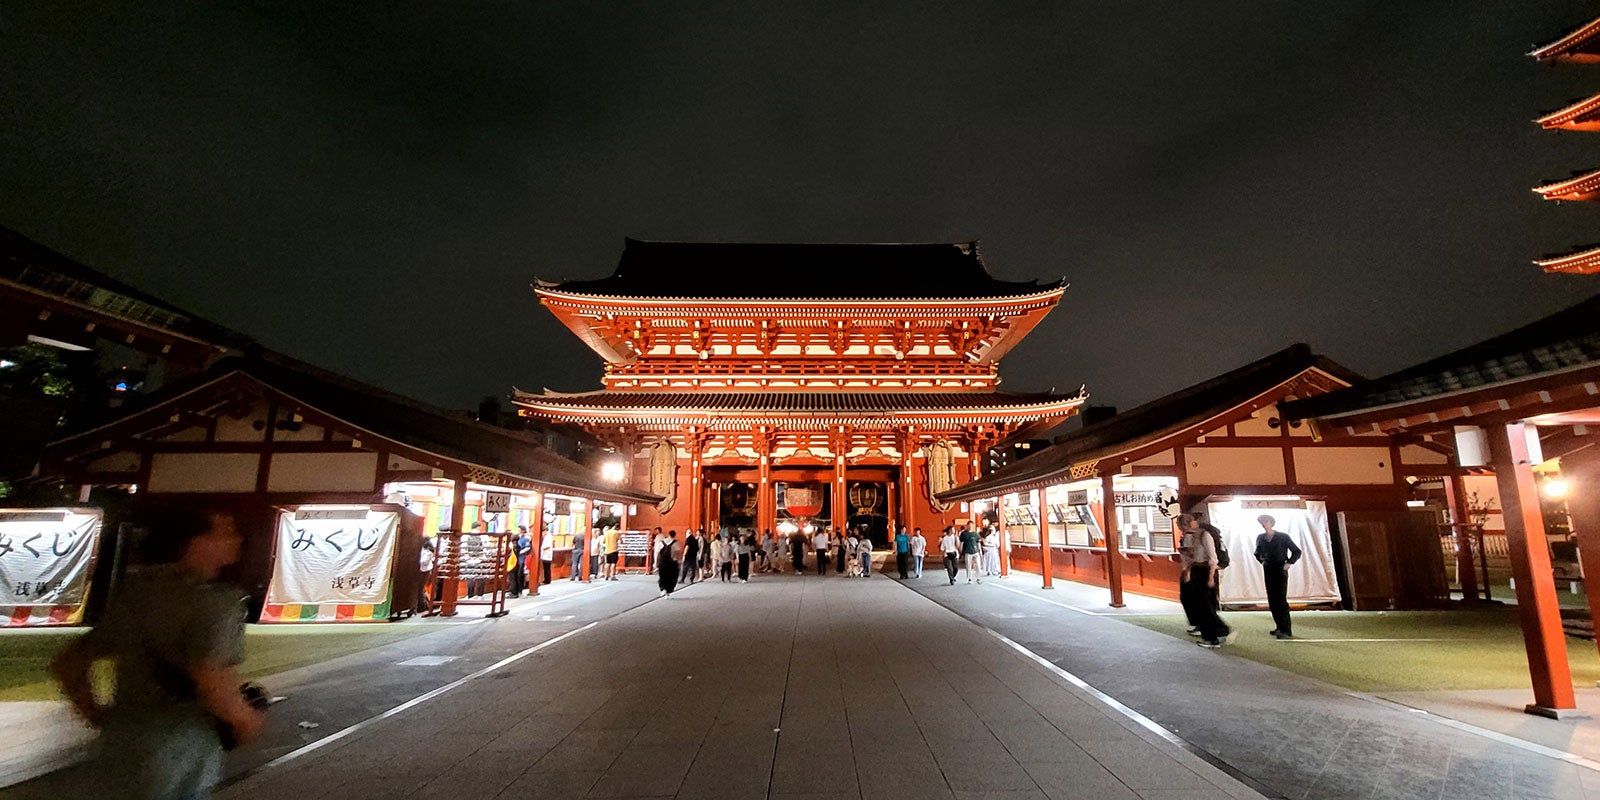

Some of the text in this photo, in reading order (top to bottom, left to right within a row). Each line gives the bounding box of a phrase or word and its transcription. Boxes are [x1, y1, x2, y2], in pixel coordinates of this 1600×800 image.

[291, 528, 379, 553] みくじ
[330, 576, 376, 589] 浅草寺
